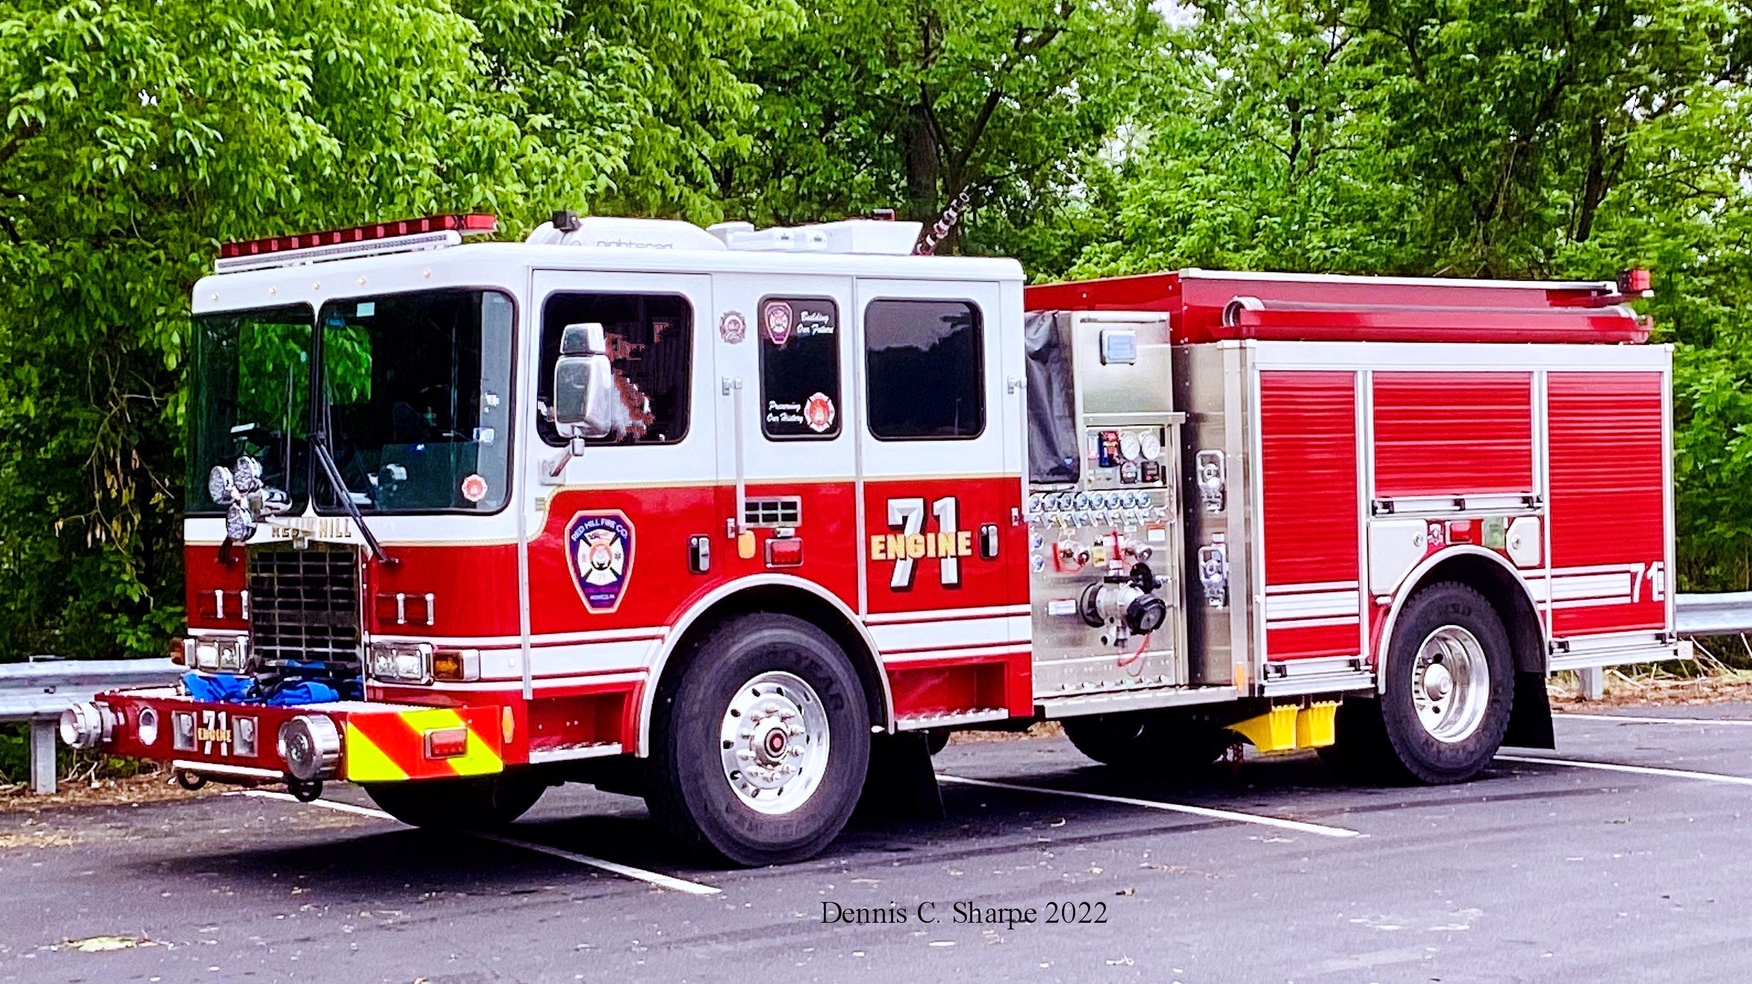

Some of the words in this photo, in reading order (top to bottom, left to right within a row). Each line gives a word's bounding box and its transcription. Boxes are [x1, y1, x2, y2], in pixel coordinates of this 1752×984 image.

[870, 531, 972, 560] ENGINE
[887, 496, 958, 588] 71
[1629, 560, 1659, 603] 71
[202, 709, 228, 756] 71
